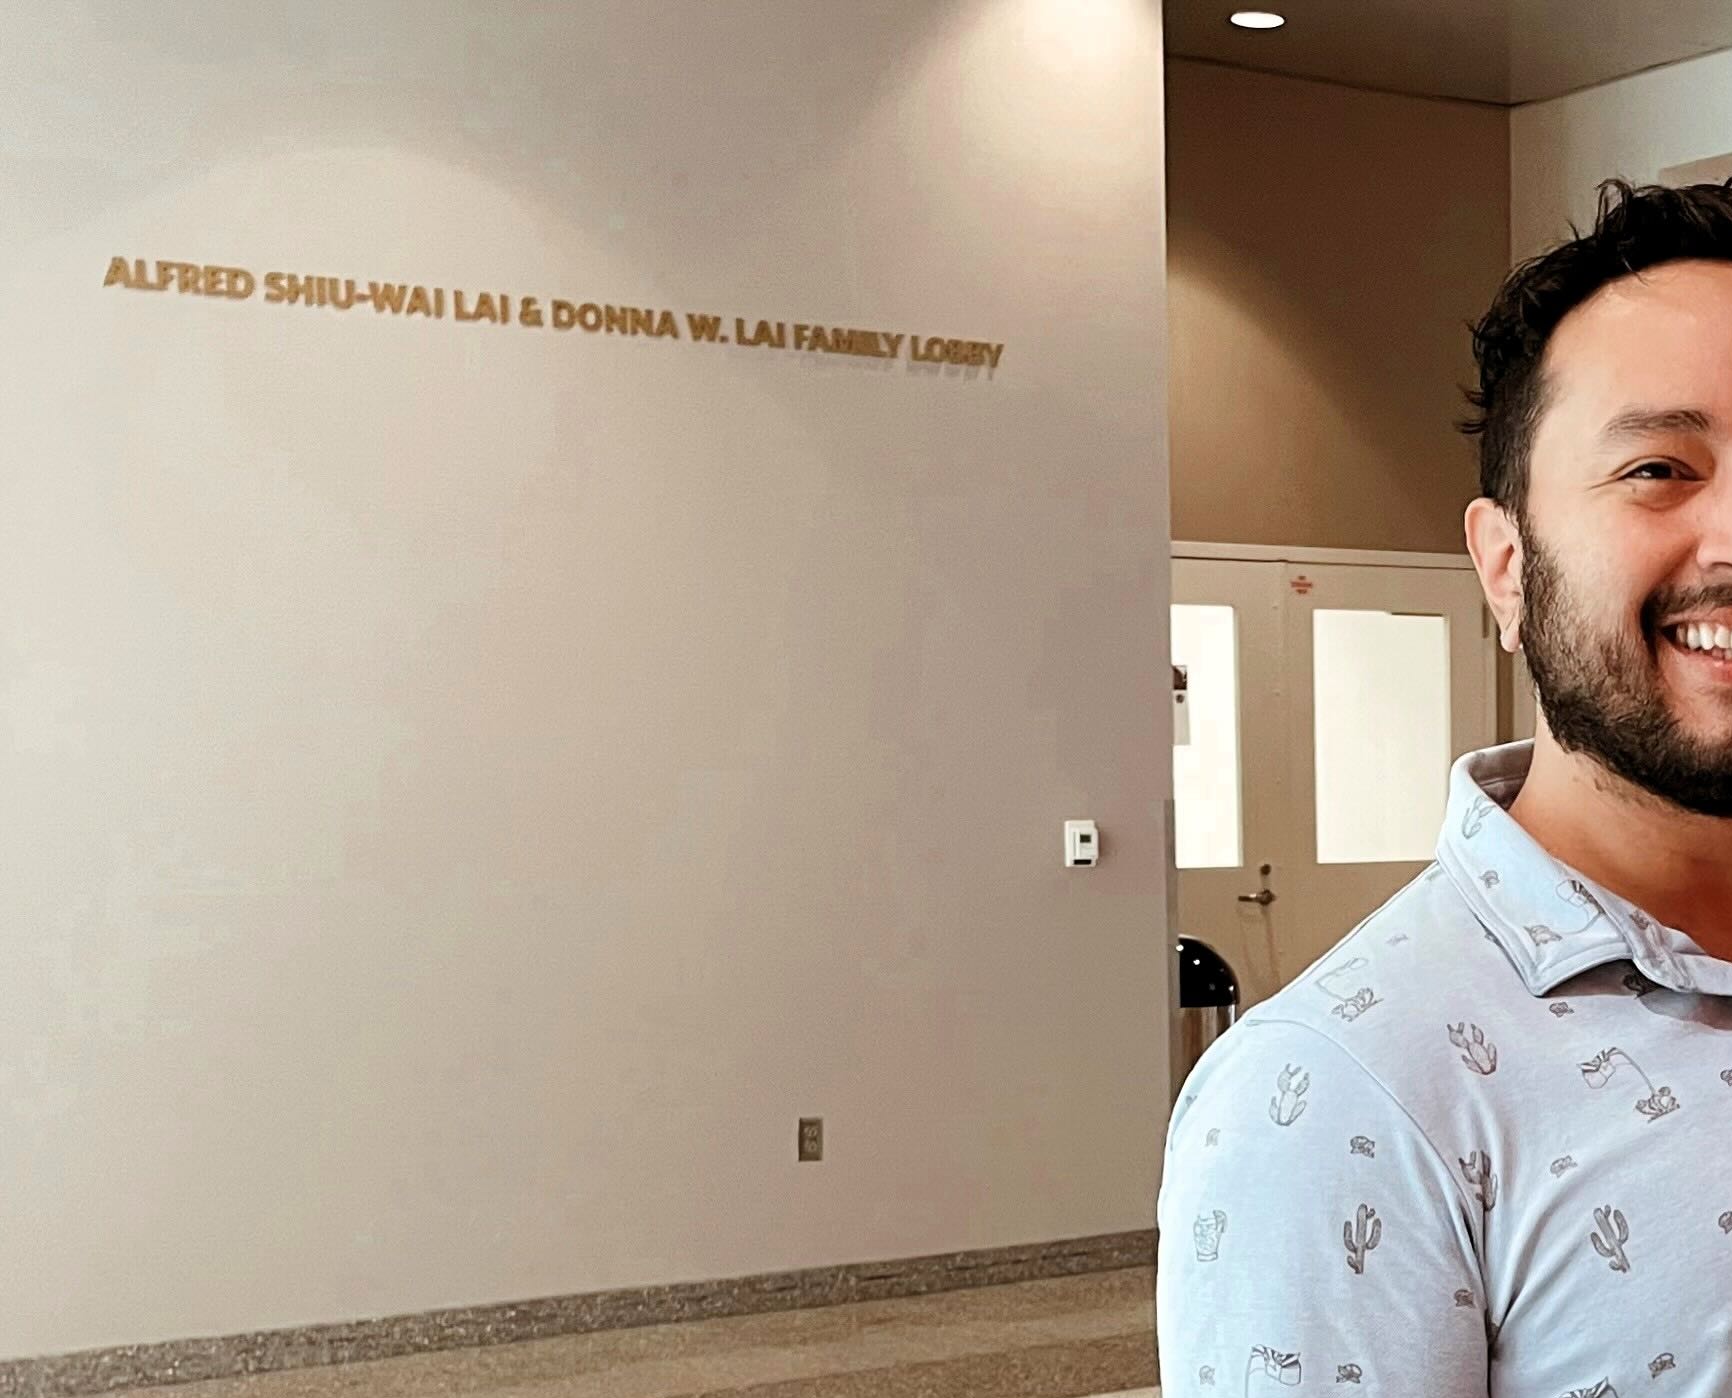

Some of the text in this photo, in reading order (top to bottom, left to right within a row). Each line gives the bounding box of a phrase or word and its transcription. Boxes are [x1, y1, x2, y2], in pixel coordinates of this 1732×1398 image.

[103, 256, 1005, 369] ALFRED SHIU-WAI LAI & DONNA W. LAI FAMILY LOBBY
